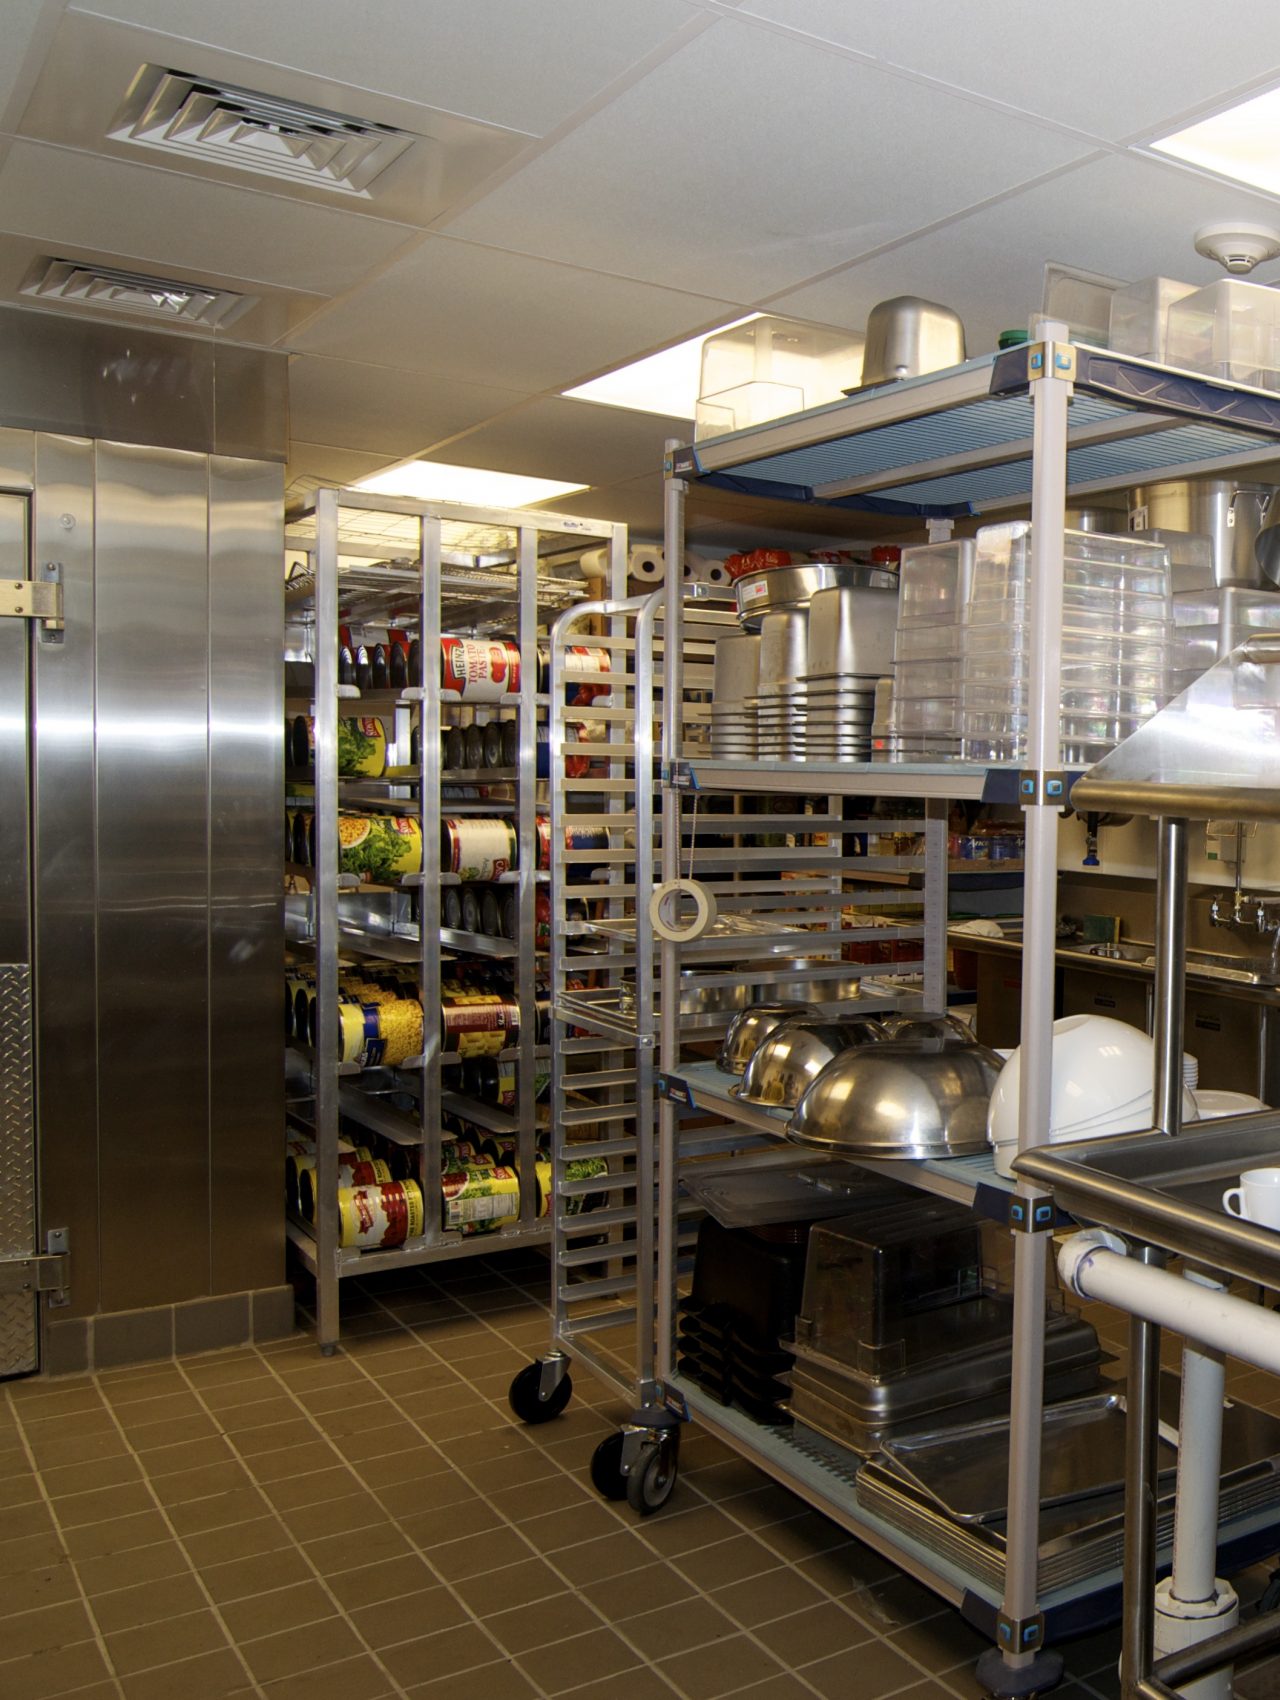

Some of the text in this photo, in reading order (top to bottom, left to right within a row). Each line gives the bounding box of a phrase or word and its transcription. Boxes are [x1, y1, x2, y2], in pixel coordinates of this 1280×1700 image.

[454, 648, 466, 676] HEINZ
[467, 643, 478, 684] TOMATO
[477, 648, 488, 679] PASTE
